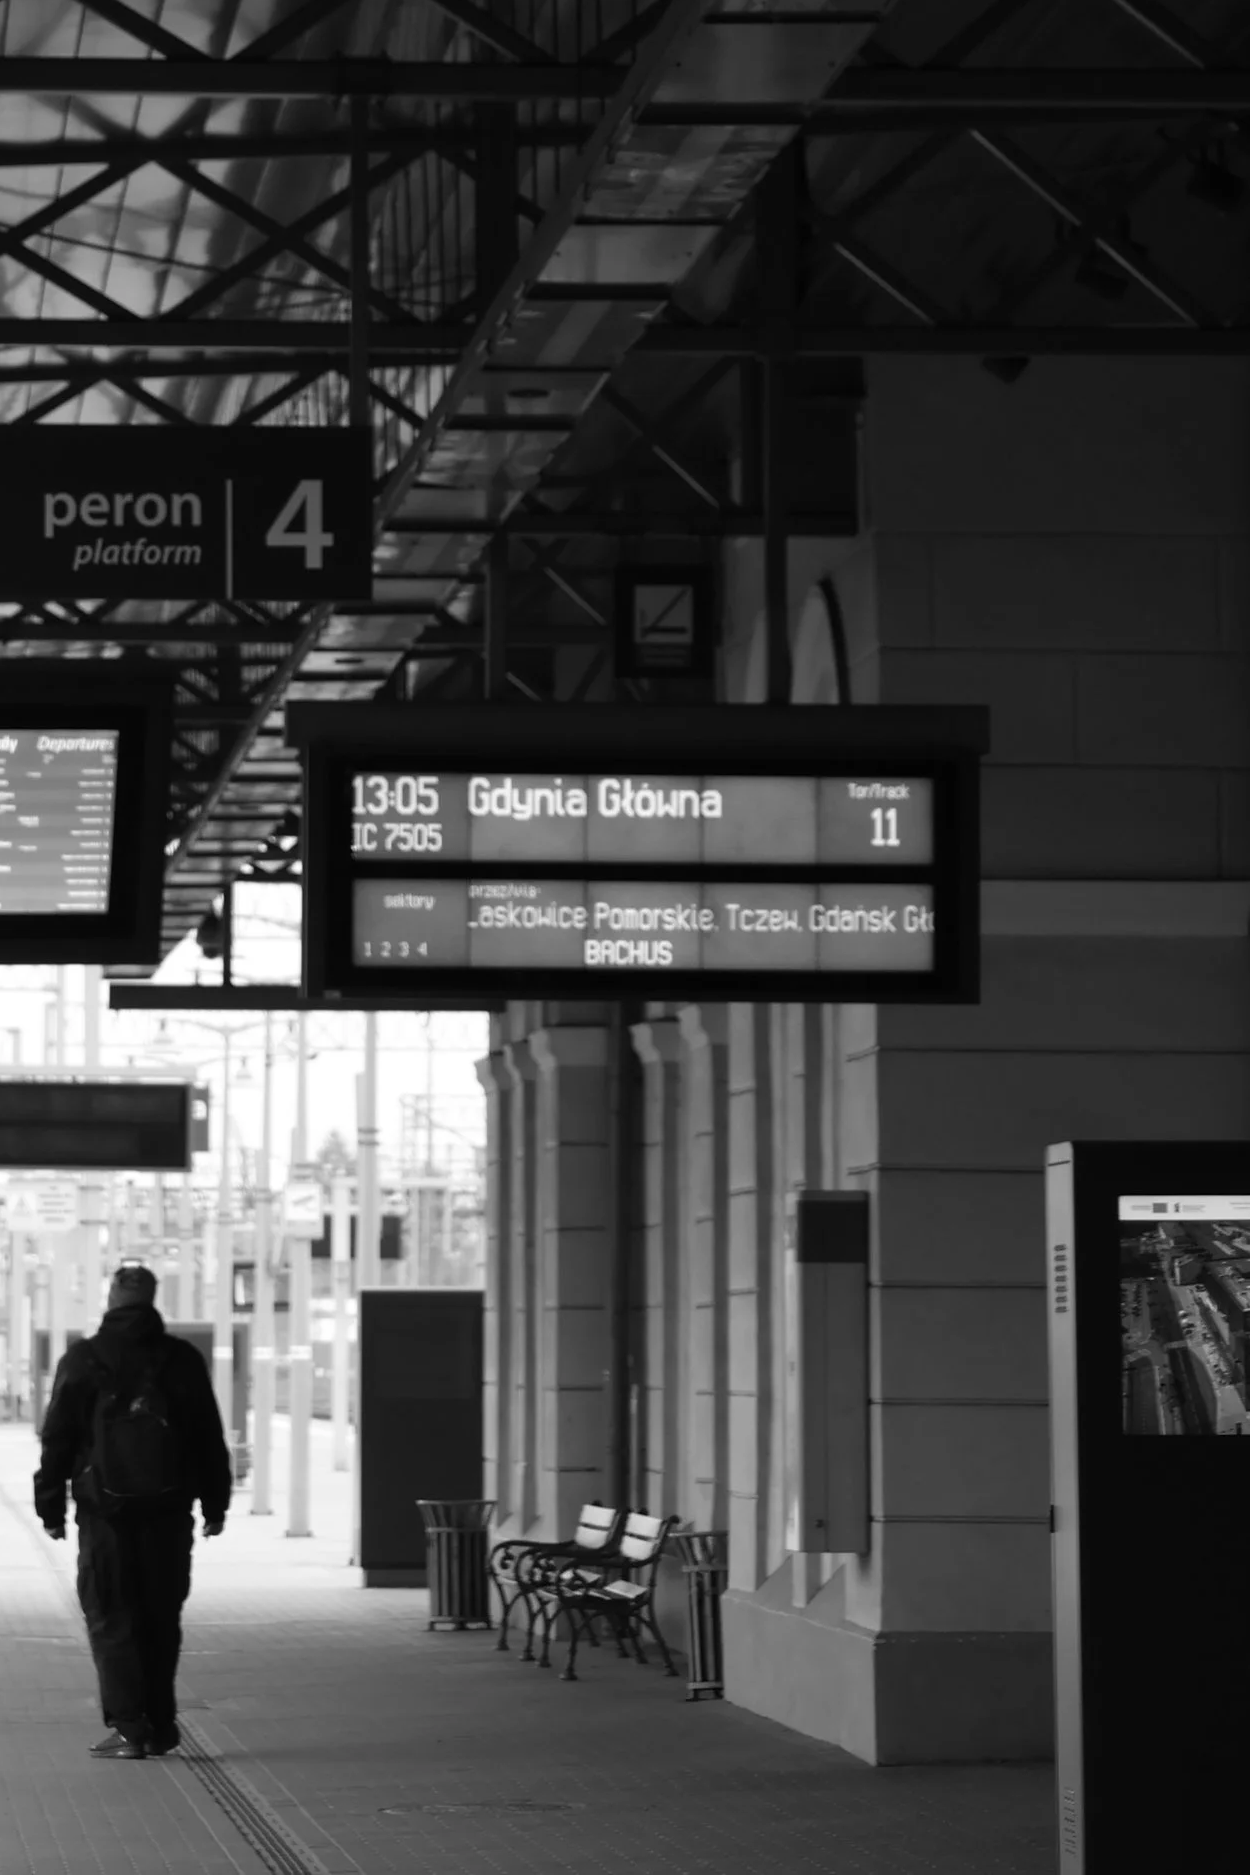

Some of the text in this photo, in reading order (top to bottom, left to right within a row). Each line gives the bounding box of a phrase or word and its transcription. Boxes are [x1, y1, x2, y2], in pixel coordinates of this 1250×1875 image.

[43, 491, 203, 539] peron
[264, 478, 335, 571] 4
[72, 537, 203, 571] platform
[37, 736, 115, 753] Departures
[352, 775, 723, 821] 13:05 Gdynia Główna
[352, 823, 442, 852] IC 7505
[869, 807, 901, 847] 11
[809, 904, 897, 933] Gdańsk
[363, 941, 428, 958] 1 2 3 4
[585, 939, 674, 966] BACHUS
